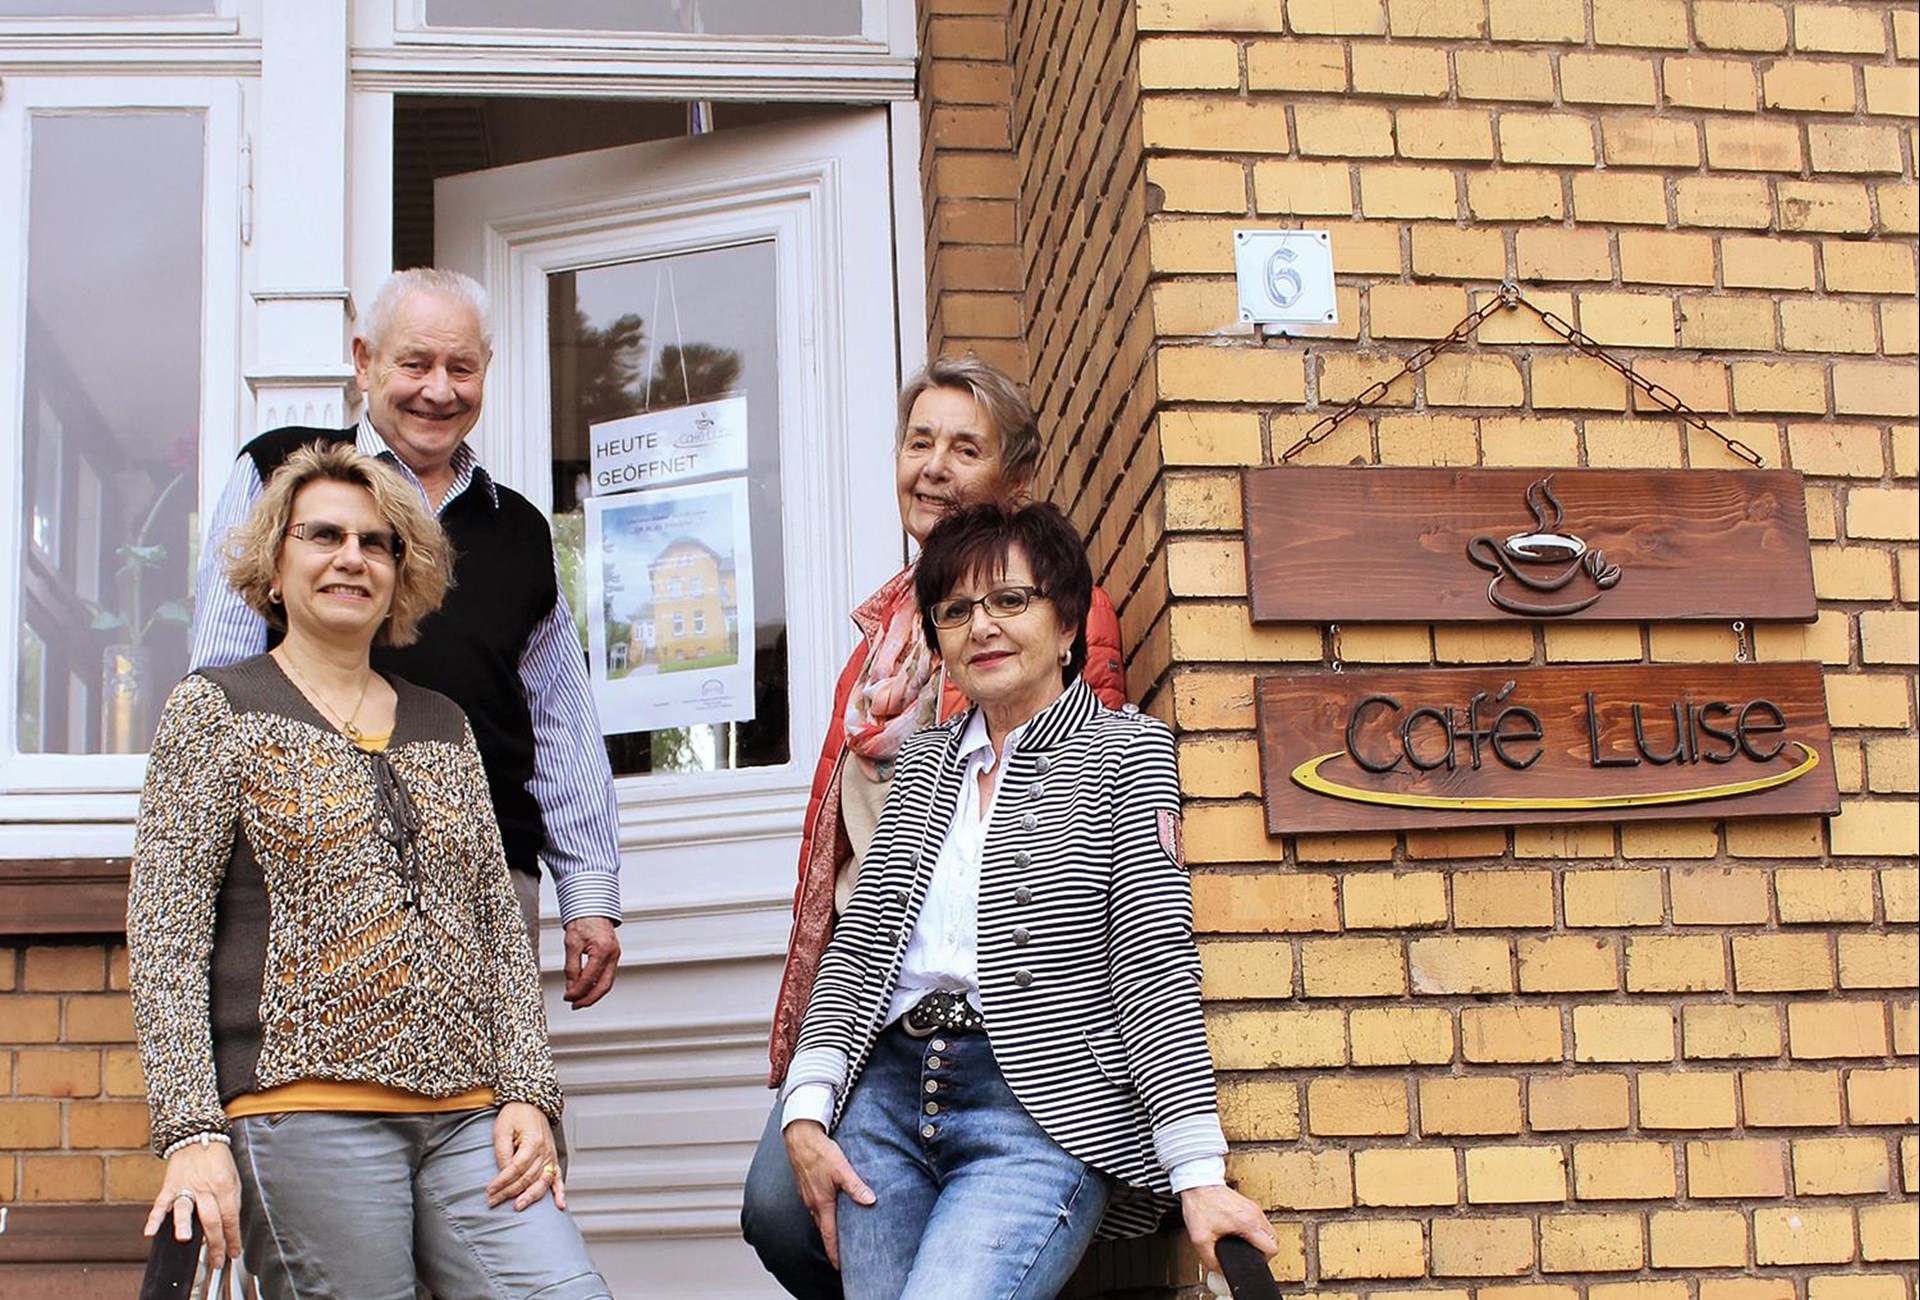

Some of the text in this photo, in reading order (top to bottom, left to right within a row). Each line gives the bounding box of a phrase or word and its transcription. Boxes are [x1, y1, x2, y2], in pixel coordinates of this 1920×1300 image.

[1263, 247, 1304, 308] 6
[597, 432, 658, 458] HEUTE
[597, 454, 698, 487] GEÖFFNET
[1347, 680, 1787, 773] Café Luise
